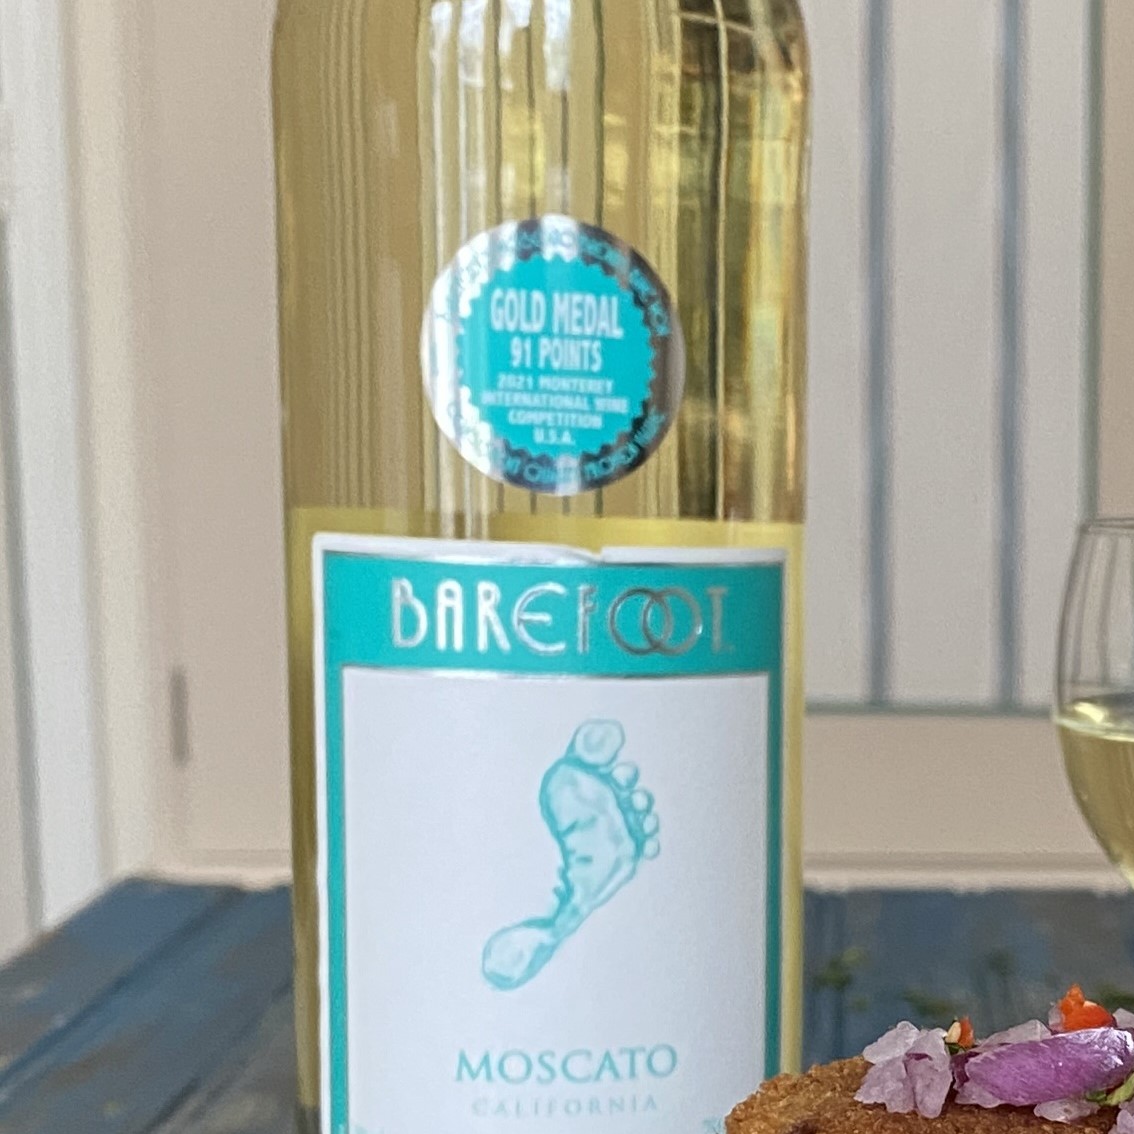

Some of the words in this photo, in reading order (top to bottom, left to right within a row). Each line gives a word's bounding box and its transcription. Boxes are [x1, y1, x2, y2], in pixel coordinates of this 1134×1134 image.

[491, 289, 546, 333] GOLD
[552, 292, 624, 338] MEDAL
[510, 336, 532, 368] 91
[538, 337, 602, 372] POINTS
[480, 390, 589, 410] INTERNATIONAL
[508, 409, 603, 429] COMPETITION
[390, 577, 735, 656] BAREFOOT
[454, 1044, 678, 1084] MOSCATO
[473, 1094, 658, 1116] CALIFORNIA
